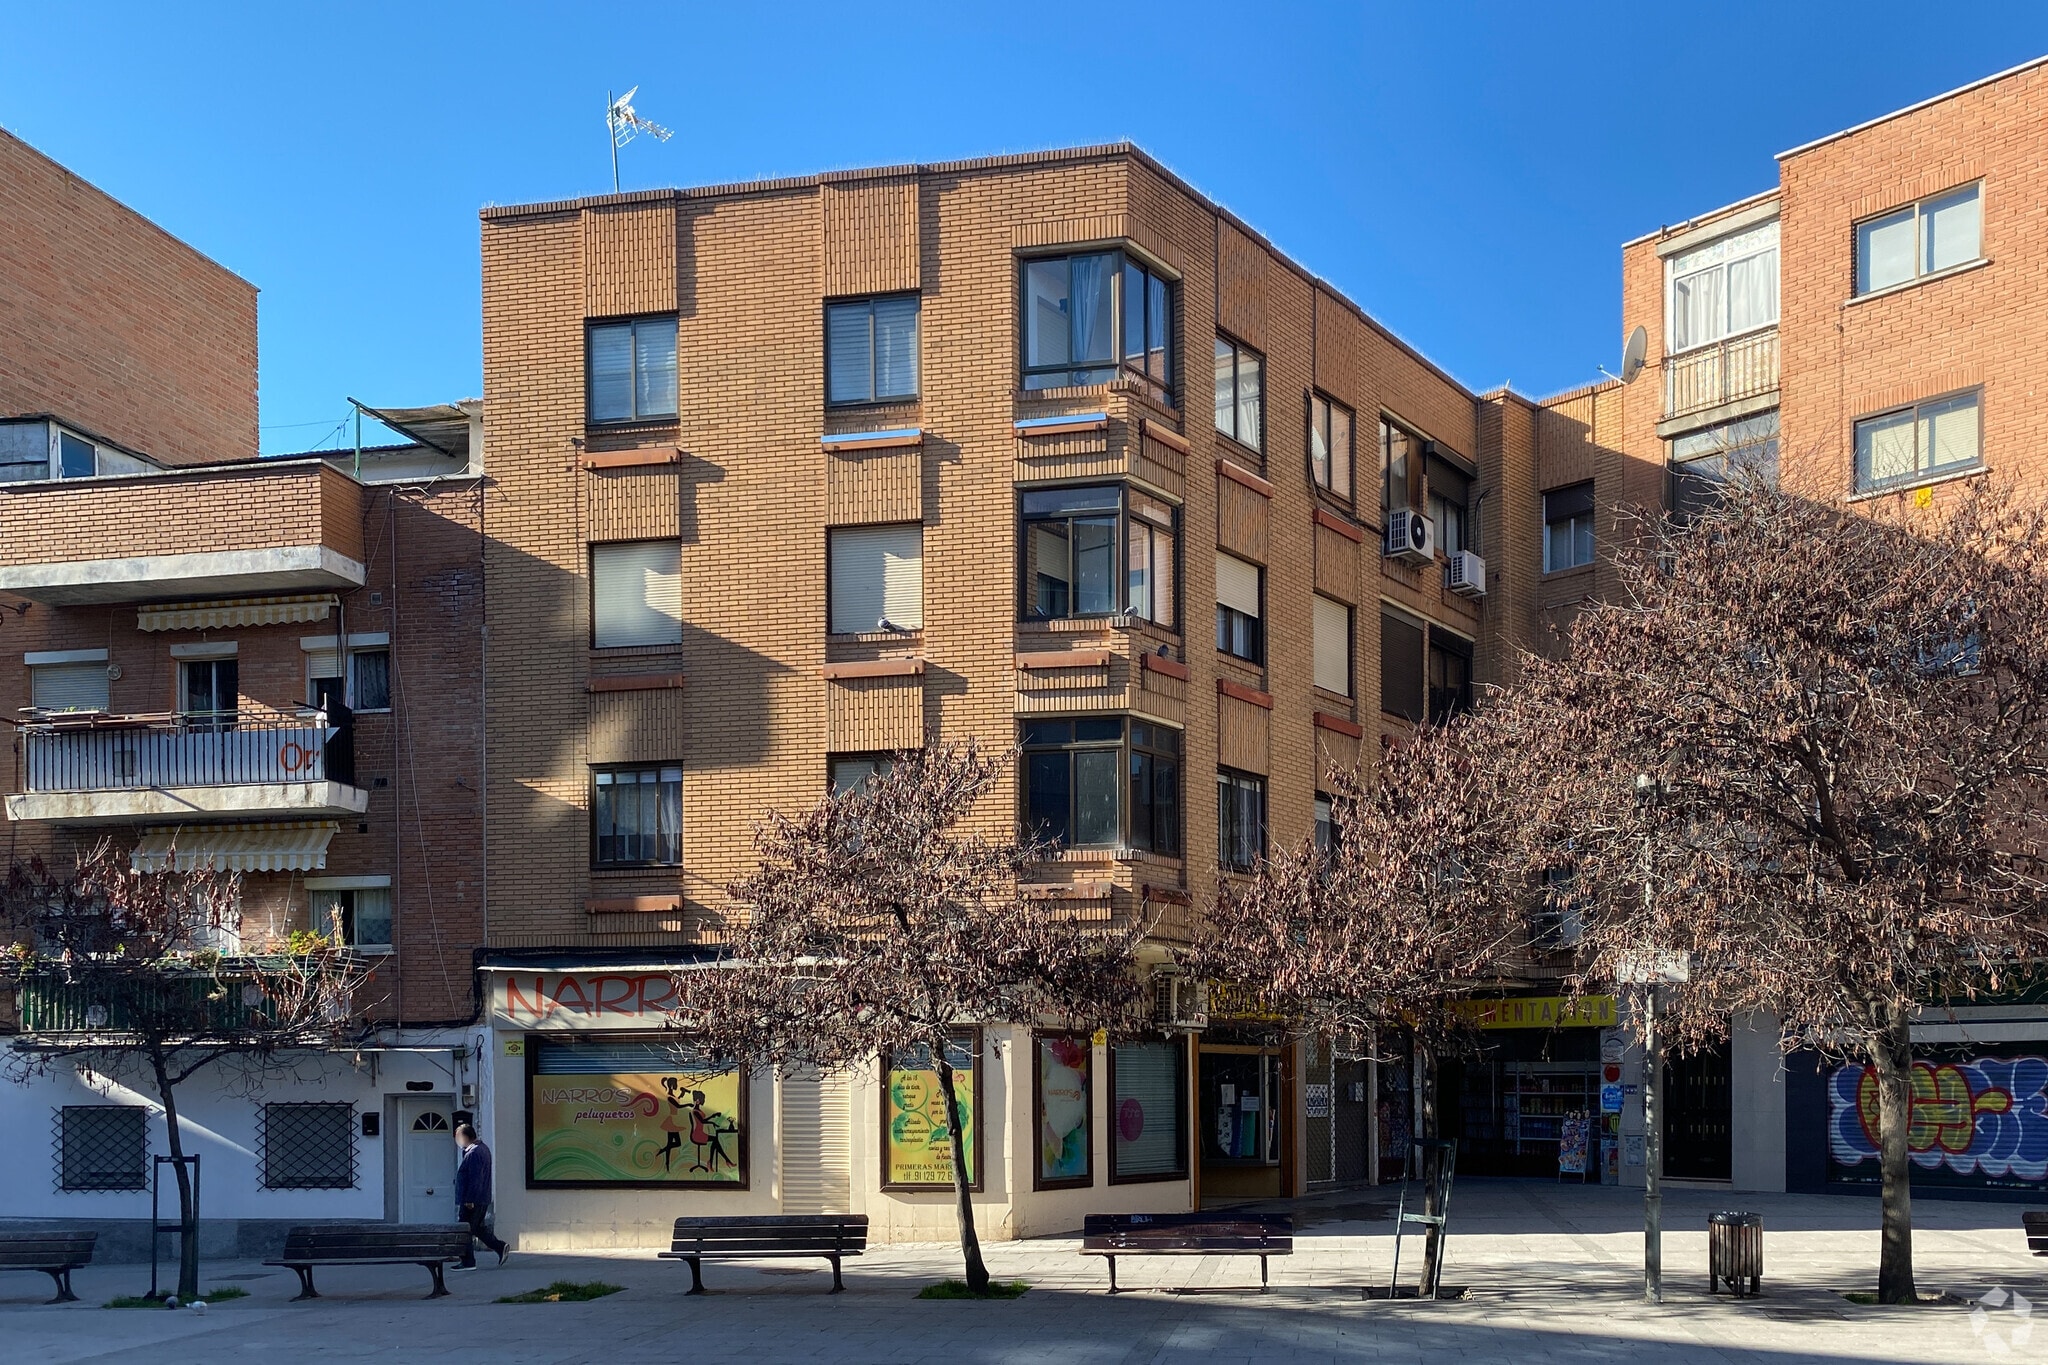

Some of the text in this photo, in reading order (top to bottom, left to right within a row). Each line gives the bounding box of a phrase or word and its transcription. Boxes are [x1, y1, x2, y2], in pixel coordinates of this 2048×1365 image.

[506, 974, 690, 1019] NARR
[541, 1087, 632, 1105] NARRO'S
[573, 1107, 635, 1125] peluqueros
[923, 1171, 935, 1181] 129
[937, 1171, 945, 1181] 72
